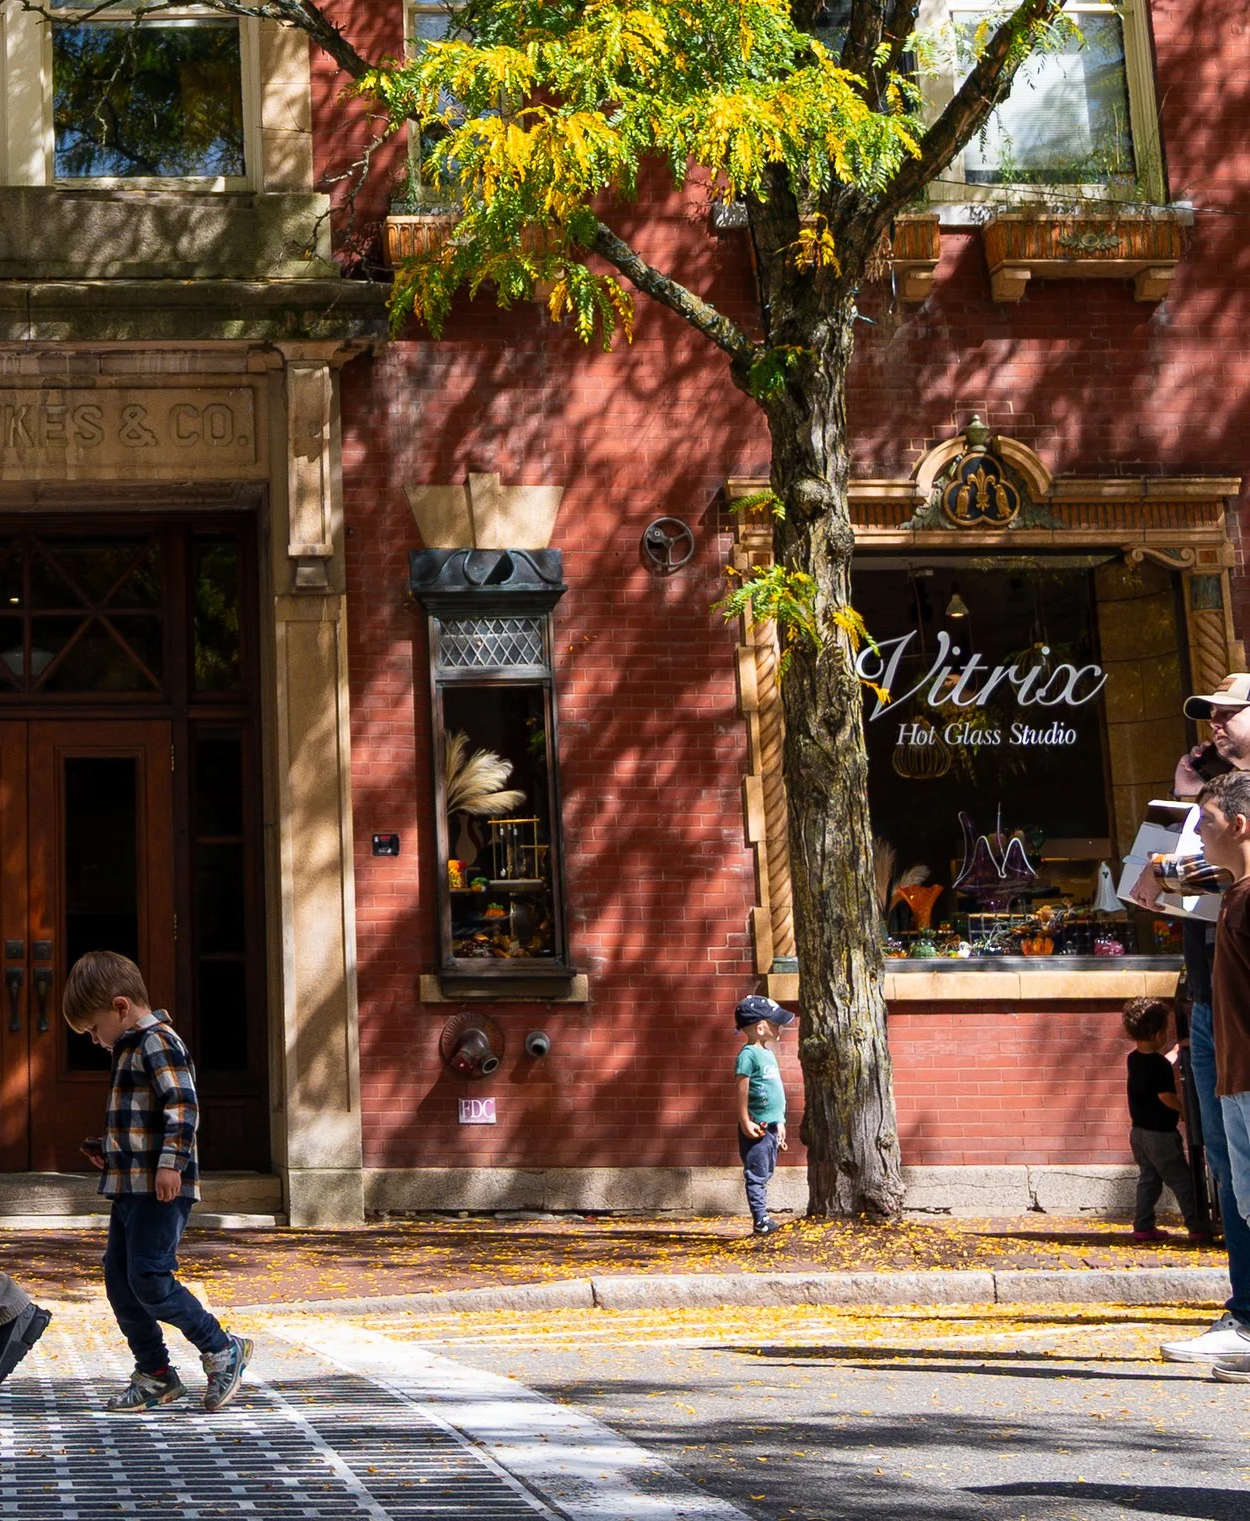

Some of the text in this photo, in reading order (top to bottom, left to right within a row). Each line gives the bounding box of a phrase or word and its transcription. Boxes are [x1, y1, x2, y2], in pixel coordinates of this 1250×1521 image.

[118, 404, 158, 447] &
[169, 404, 249, 447] CO.
[854, 629, 1109, 722] Vitrix
[895, 721, 1078, 746] Hot Glass Studio
[461, 1099, 493, 1118] FDC
